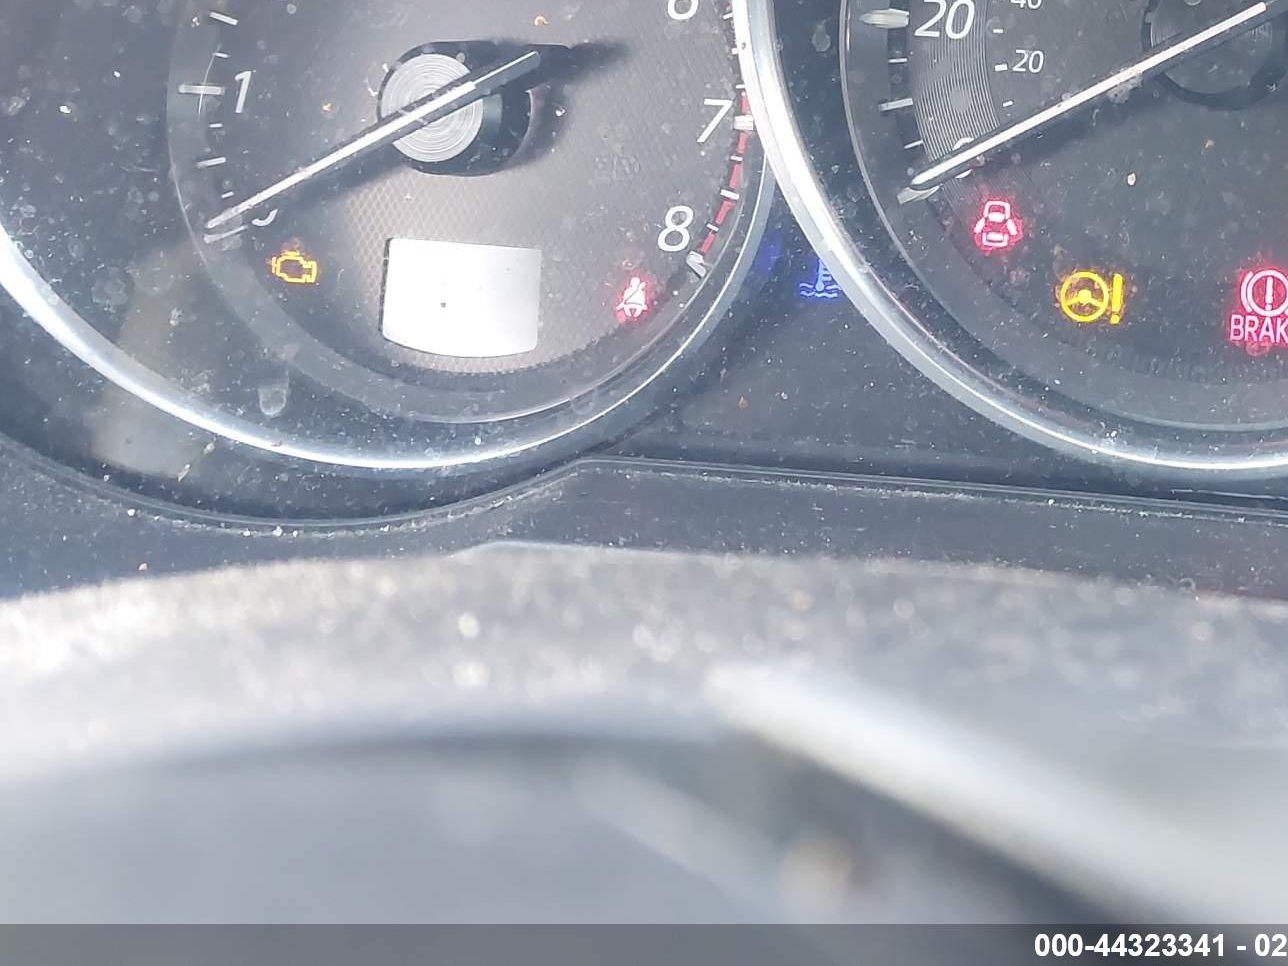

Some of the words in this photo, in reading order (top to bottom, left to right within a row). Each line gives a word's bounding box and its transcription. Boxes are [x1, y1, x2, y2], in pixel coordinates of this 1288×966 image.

[1012, 49, 1044, 73] 20
[234, 70, 253, 114] 1
[697, 98, 732, 143] 7
[657, 205, 694, 251] 8
